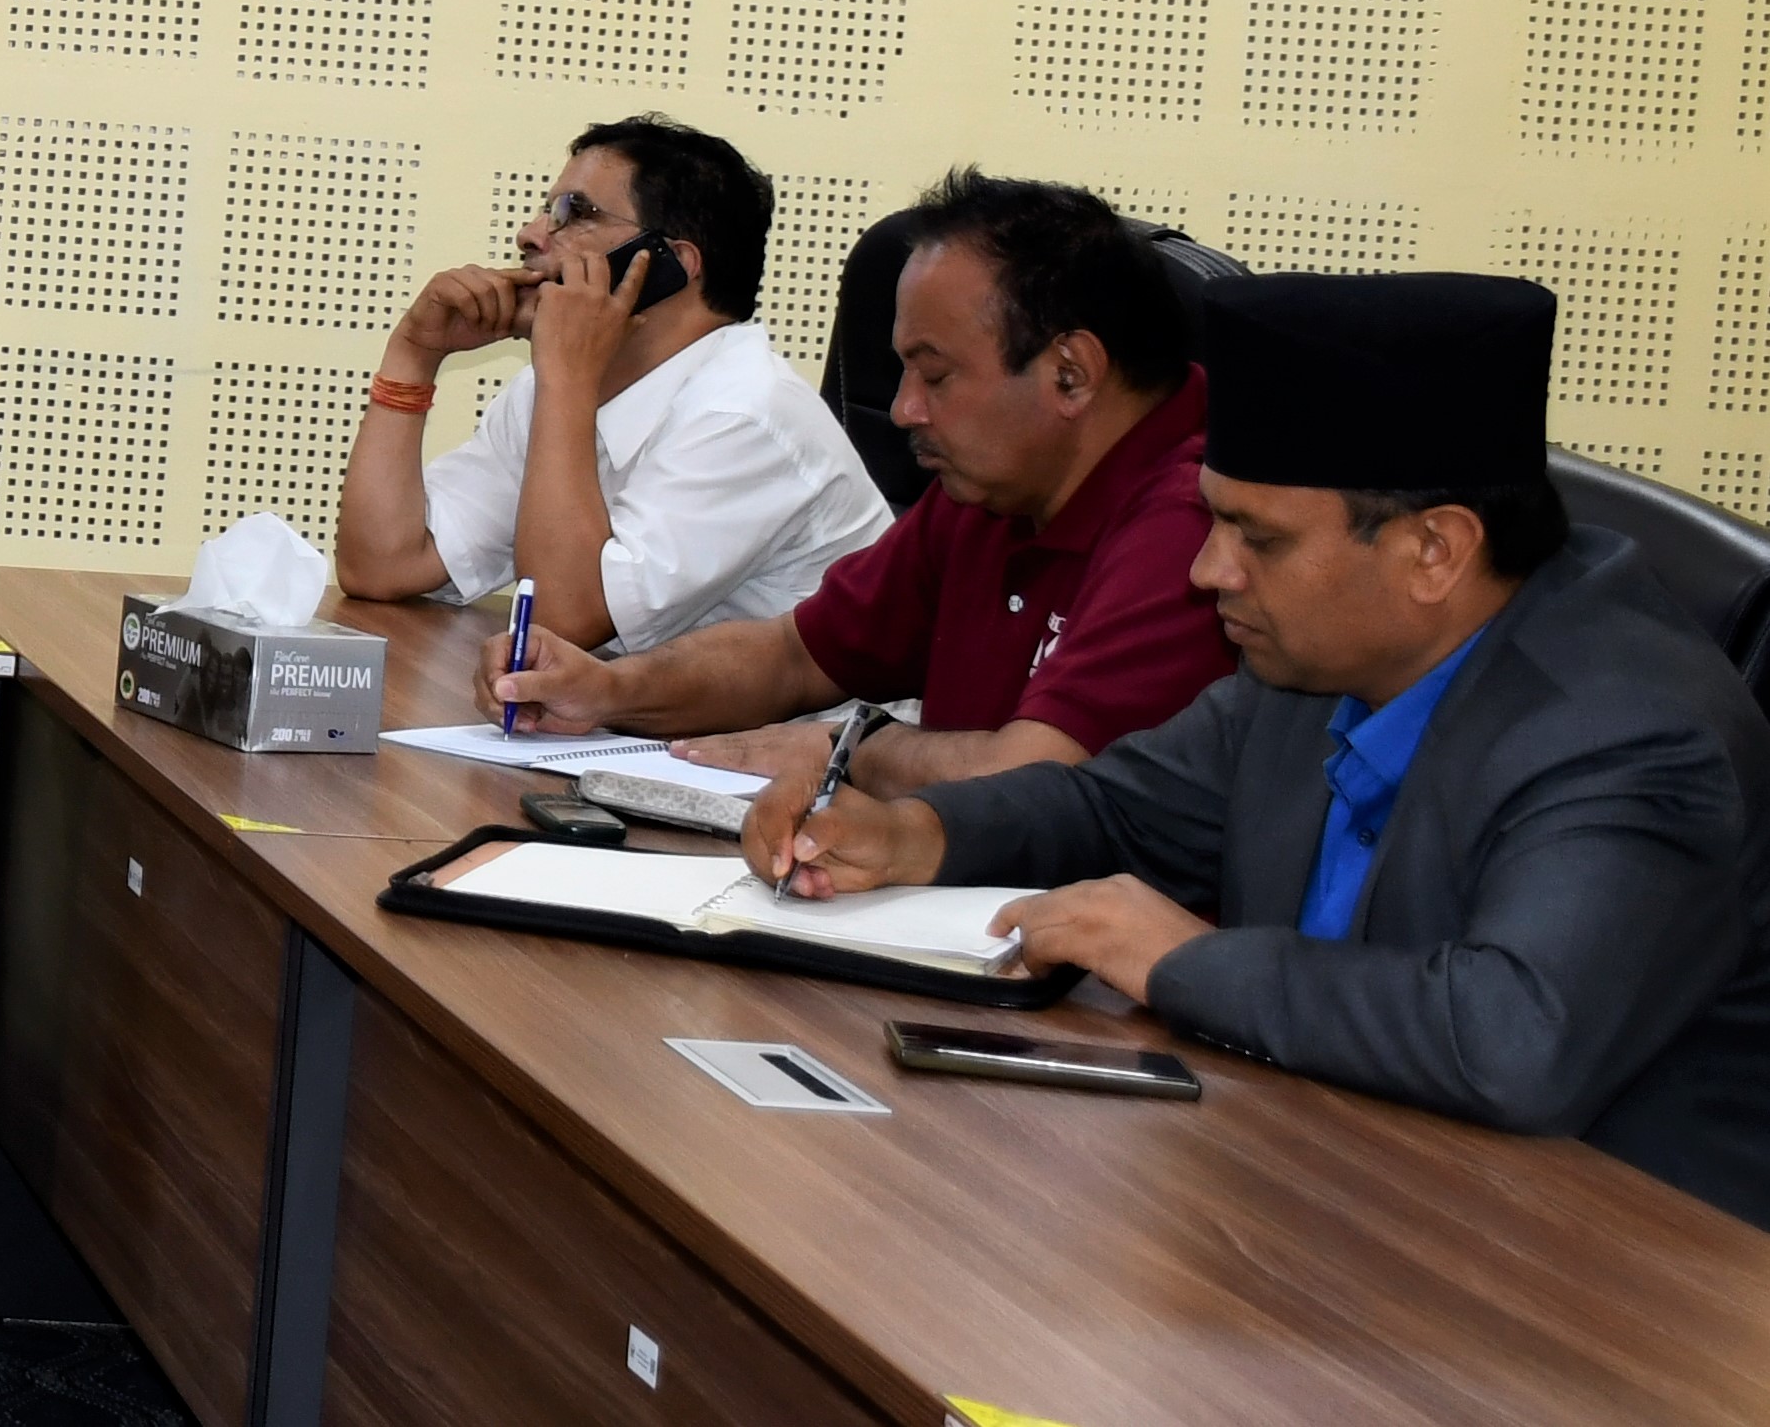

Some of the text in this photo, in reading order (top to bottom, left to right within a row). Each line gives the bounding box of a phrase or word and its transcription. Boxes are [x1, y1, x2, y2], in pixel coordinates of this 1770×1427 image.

[141, 625, 202, 668] PREMIUM
[270, 663, 371, 689] PREMIUM
[270, 726, 293, 742] 200
